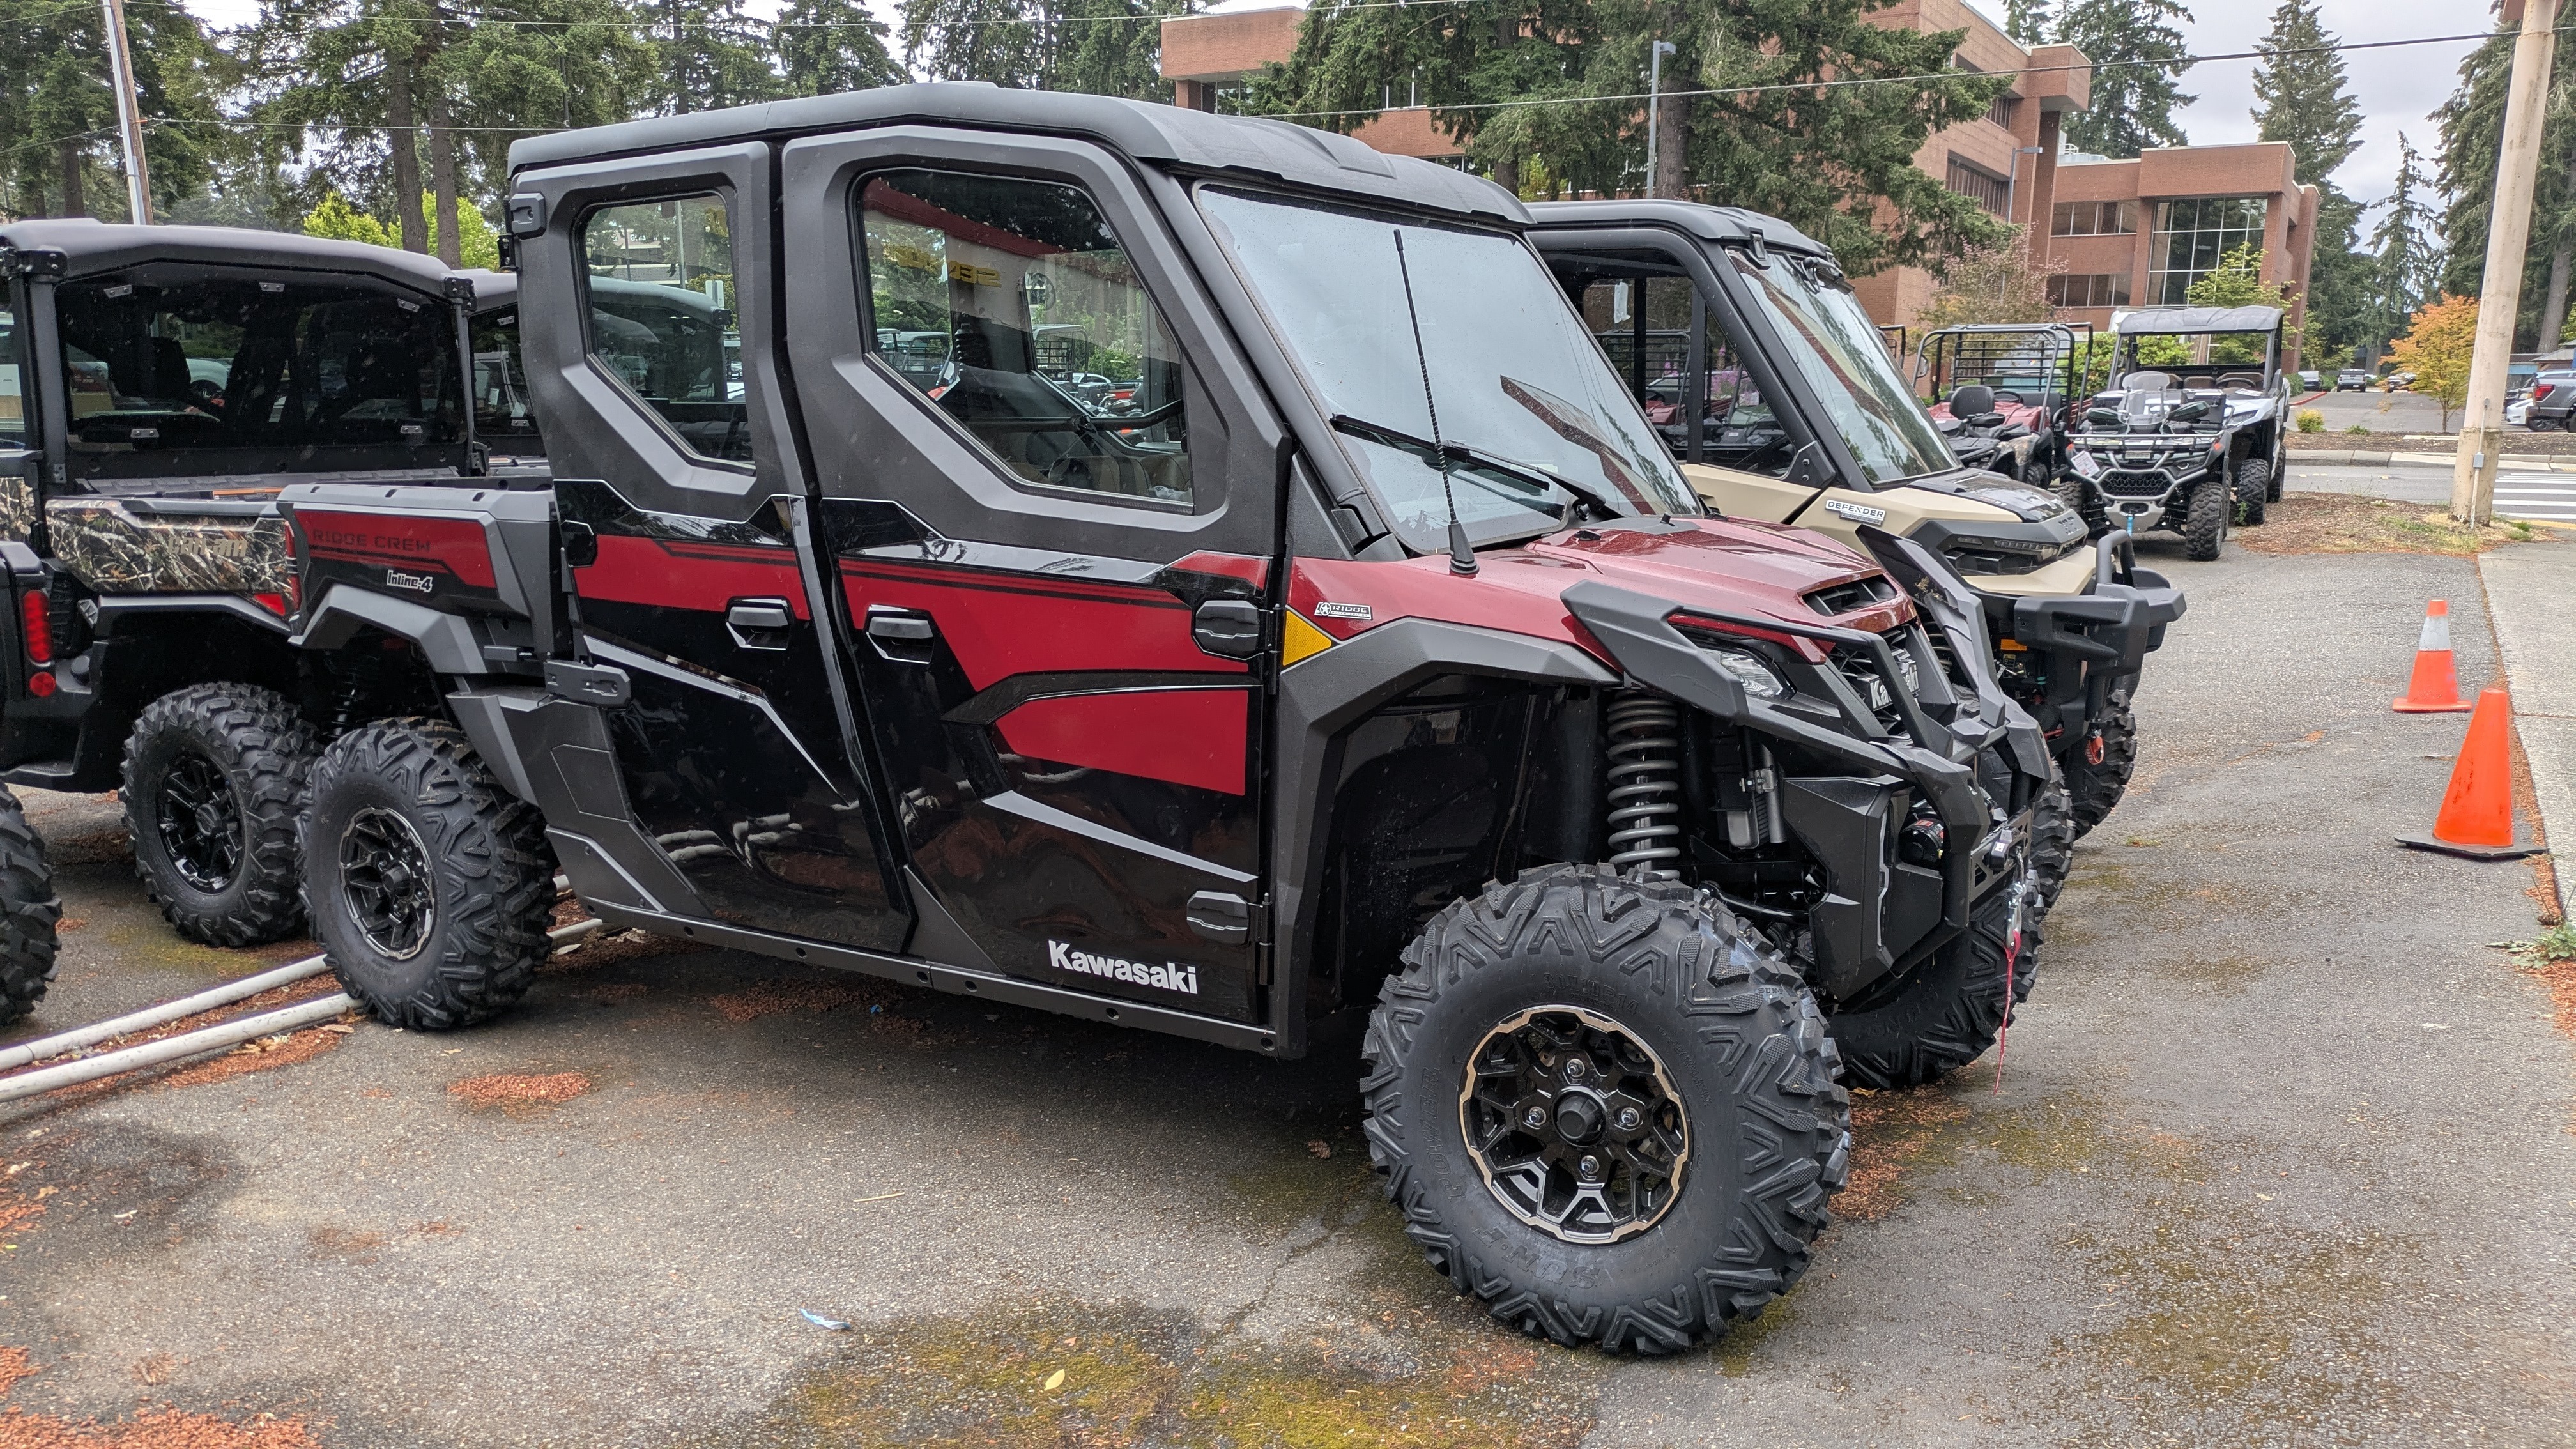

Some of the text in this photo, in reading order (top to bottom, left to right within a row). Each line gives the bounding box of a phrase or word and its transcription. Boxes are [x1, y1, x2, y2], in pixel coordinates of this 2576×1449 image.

[1827, 501, 1884, 518] DEFENDER
[313, 528, 432, 551] RIDGE CREW
[387, 569, 433, 593] Inline-4
[1869, 664, 1920, 709] Kaaki
[1048, 940, 1198, 995] Kawasaki
